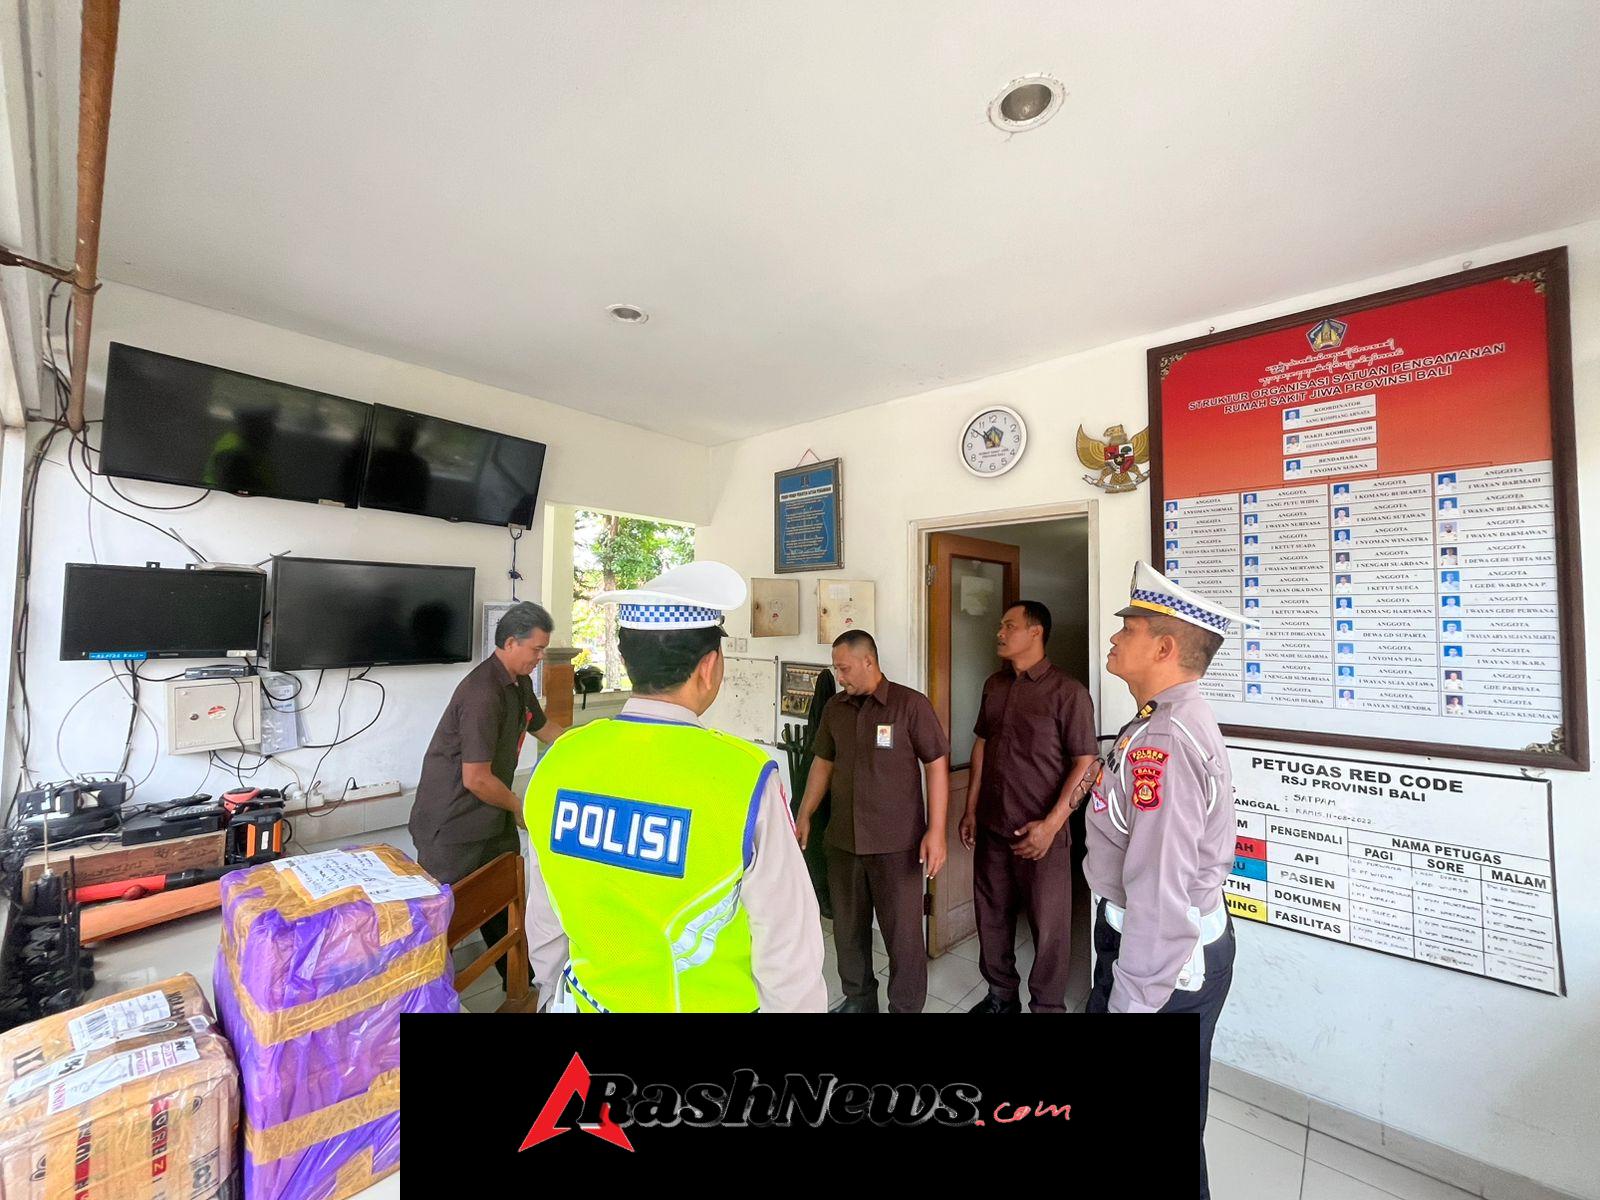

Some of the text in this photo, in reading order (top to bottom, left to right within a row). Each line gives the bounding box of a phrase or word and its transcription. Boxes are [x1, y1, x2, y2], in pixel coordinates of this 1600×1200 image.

[1188, 391, 1248, 410] STRUKTUR
[1251, 376, 1329, 398] ORGANISASI
[1332, 366, 1388, 384] SATUAN
[1392, 342, 1505, 372] PENGAMANAN
[1224, 365, 1453, 414] RUMAH SAKIT JIWA PROVINSI BALI
[1314, 401, 1361, 412] KOORDINATOR
[1325, 426, 1373, 436] KOORDINATOR
[1319, 455, 1358, 463] BENDAHARA
[1484, 467, 1523, 476] ANGGOTA
[1502, 478, 1541, 486] DARMADI
[1252, 758, 1464, 794] PETUGAS RED CODE
[1282, 775, 1426, 802] RSJ PROVINSI BALI
[1234, 798, 1280, 811] ANGGAL
[554, 800, 683, 864] POLISI
[1270, 825, 1342, 845] PENGENDALI
[1294, 853, 1319, 865] API
[1365, 848, 1394, 861] PAGI
[1392, 838, 1502, 865] NAMA PETUGAS
[1427, 859, 1464, 874] SORE
[1281, 871, 1335, 889] PASIEN
[1491, 871, 1547, 890] MALAM
[1275, 890, 1341, 912] DOKUMEN
[1275, 911, 1341, 934] FASILITAS
